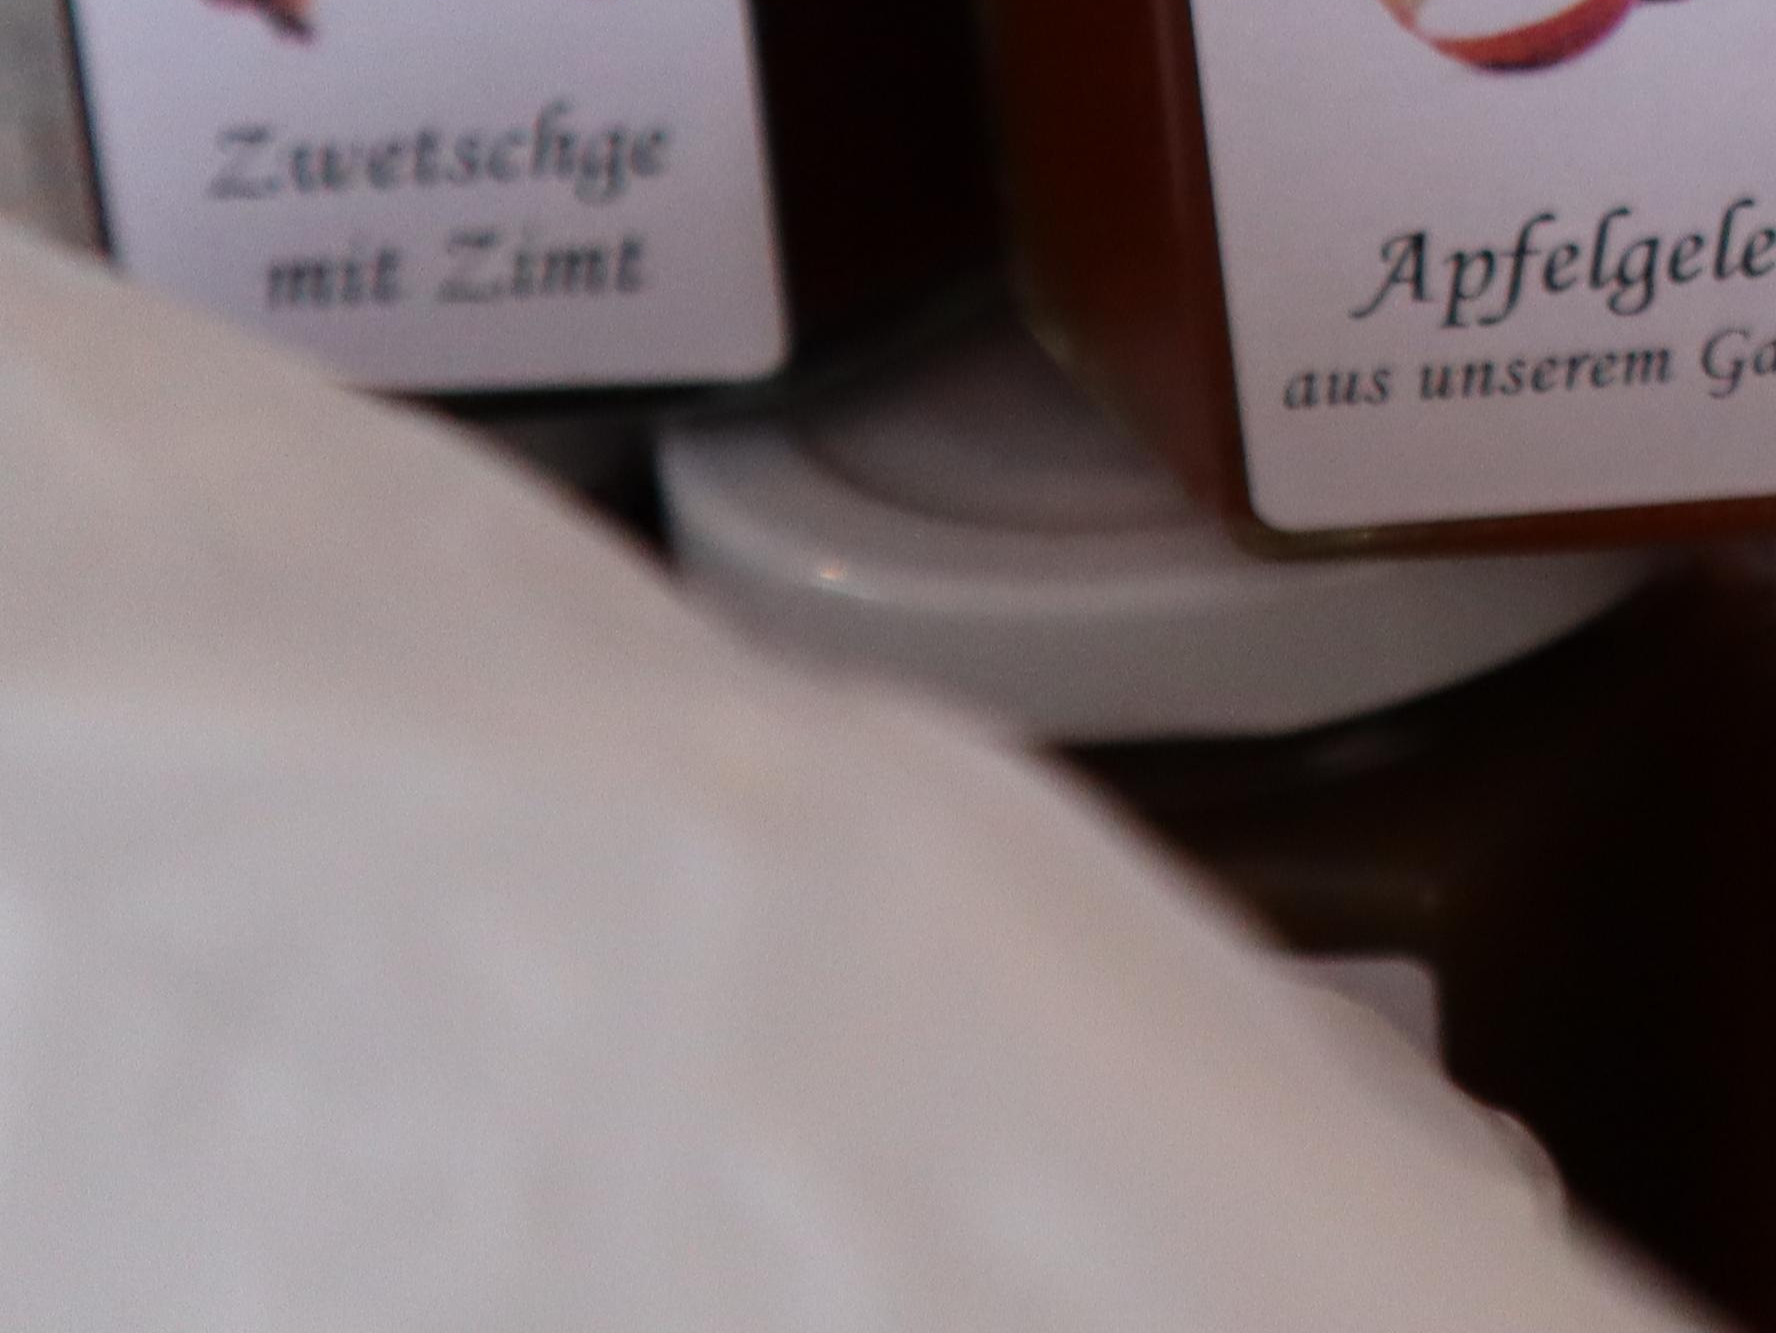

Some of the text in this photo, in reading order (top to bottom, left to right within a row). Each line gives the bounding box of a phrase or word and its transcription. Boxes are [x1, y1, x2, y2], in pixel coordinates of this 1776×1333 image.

[204, 94, 673, 206] Zwetschge
[266, 225, 647, 310] mit Zimt
[1283, 364, 1393, 410] aus
[1416, 343, 1677, 400] unserem
